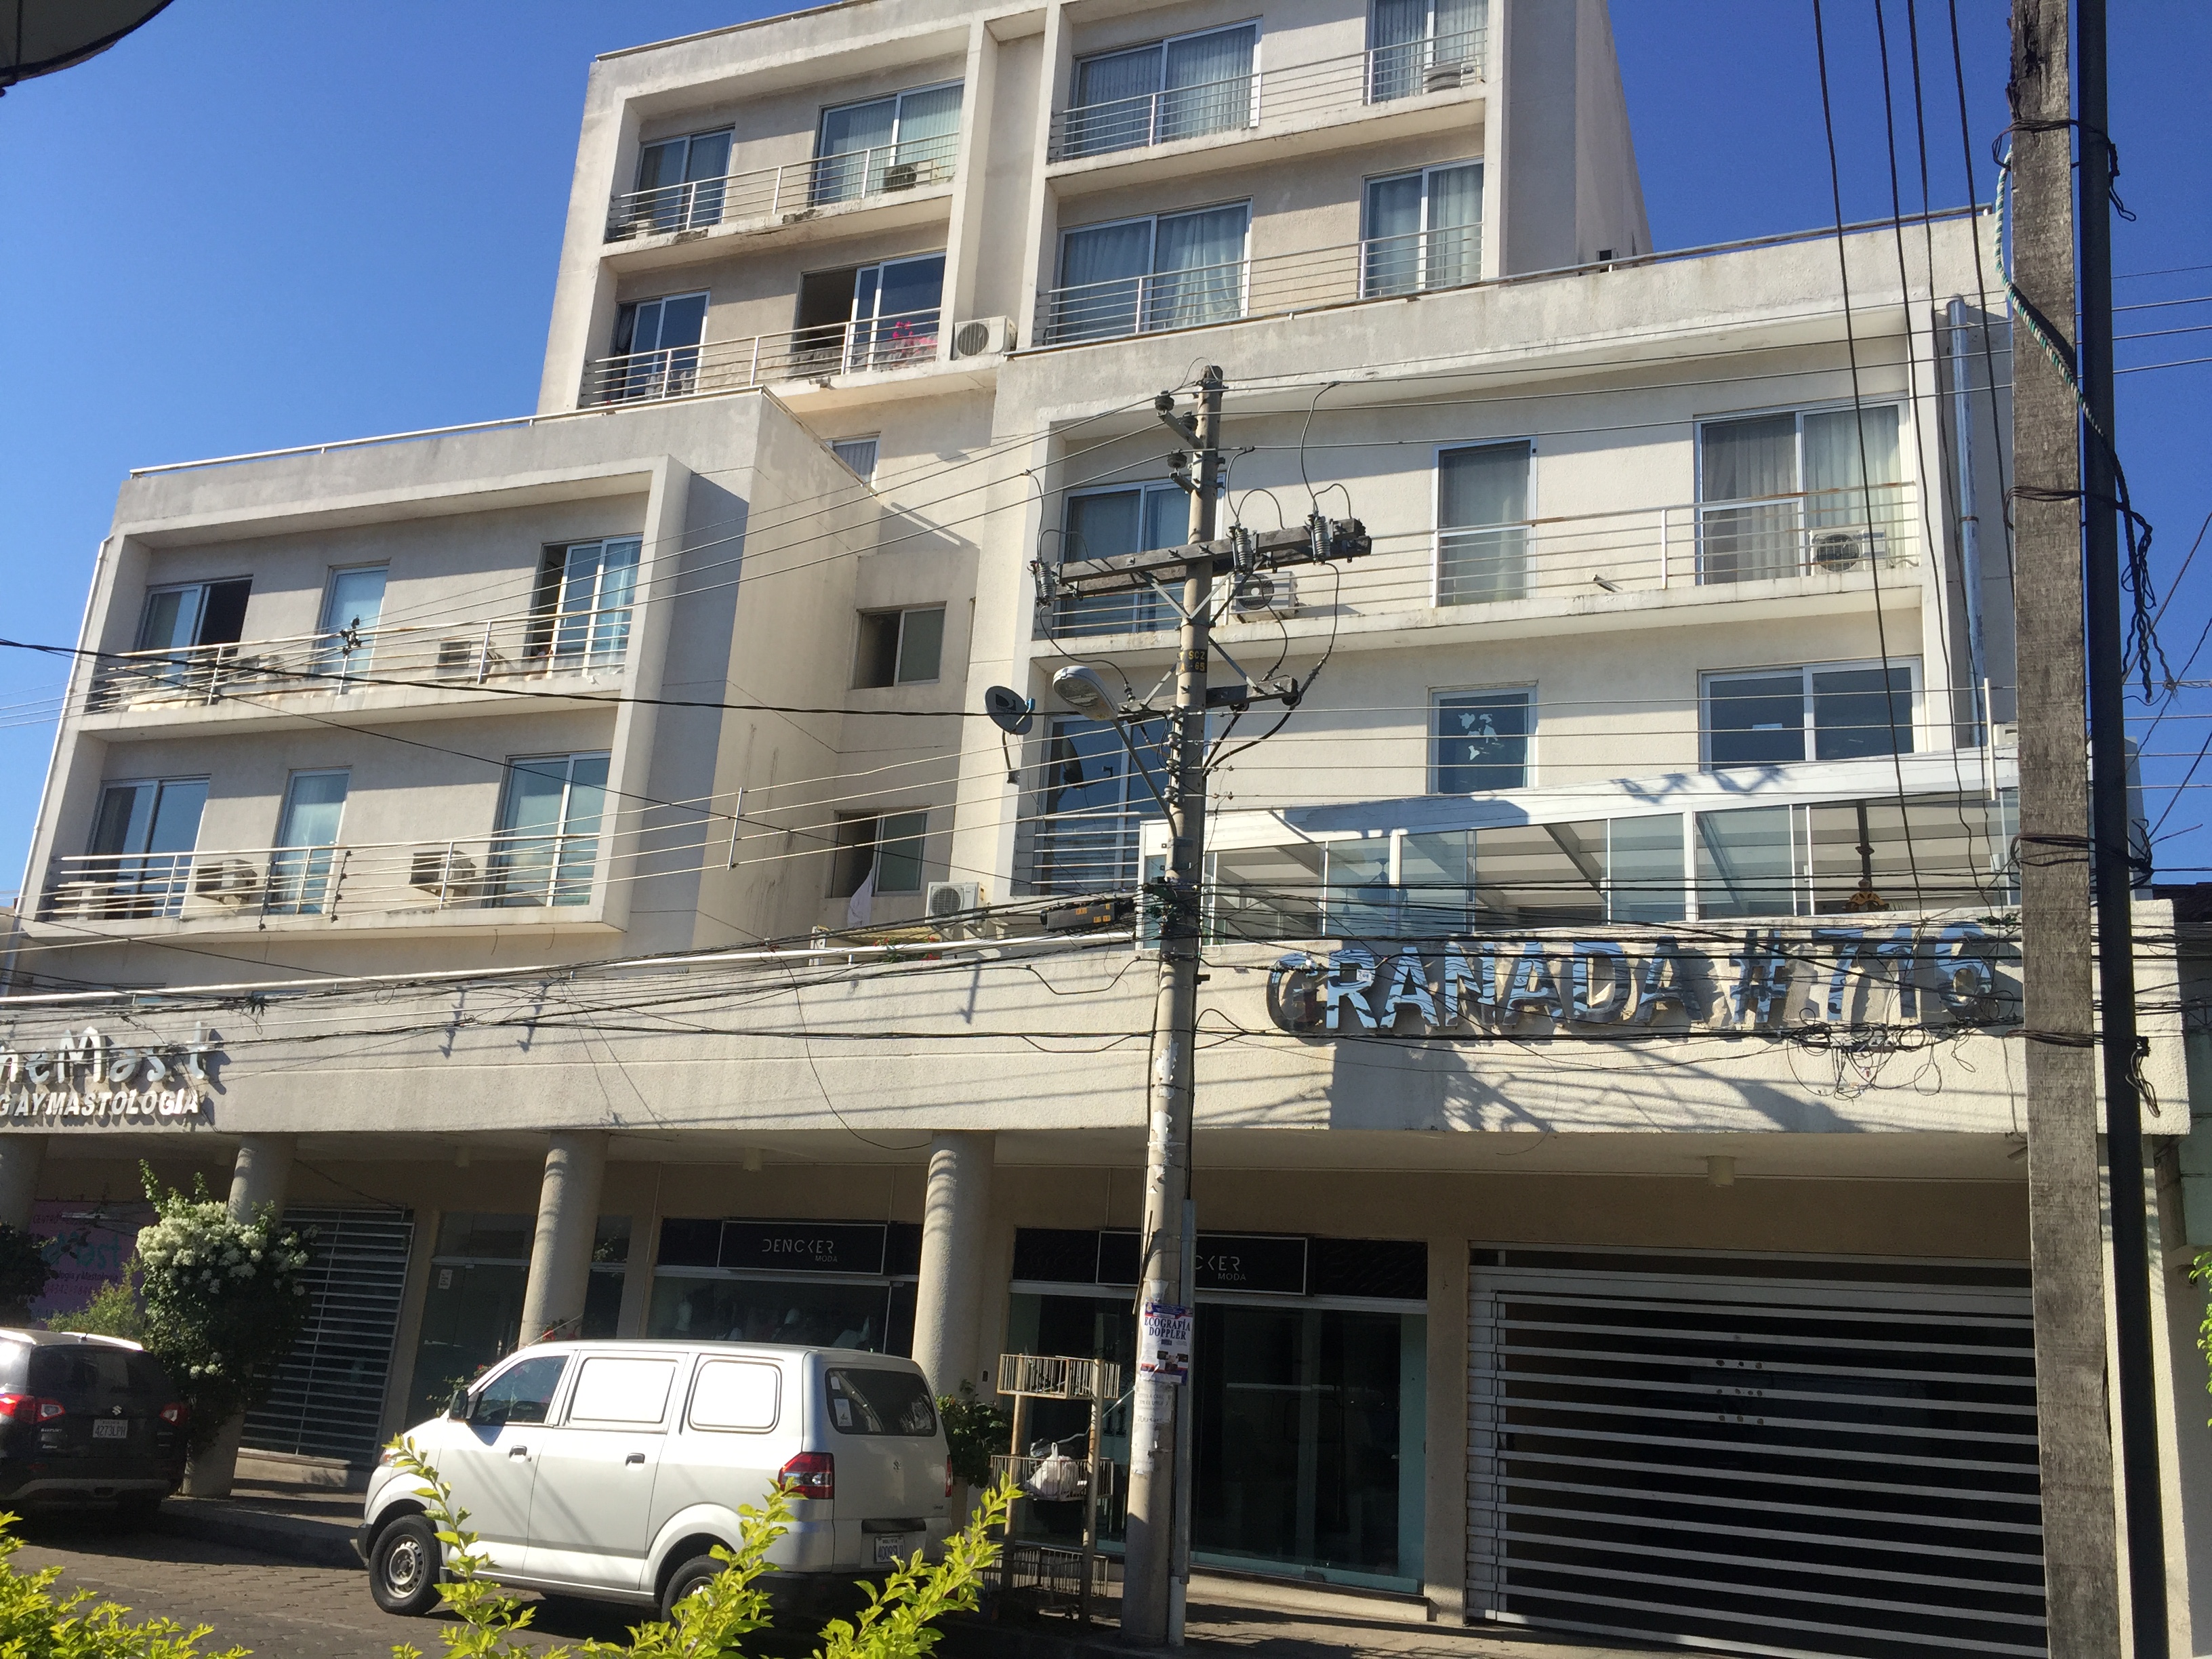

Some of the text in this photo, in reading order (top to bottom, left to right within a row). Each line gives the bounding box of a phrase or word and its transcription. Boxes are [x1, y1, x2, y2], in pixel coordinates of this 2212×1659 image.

[1189, 651, 1205, 659] SCZ
[1266, 935, 1704, 1032] GRANADA
[762, 1239, 834, 1254] DENCKER
[1195, 1254, 1240, 1271] CKER
[1218, 1273, 1246, 1281] MODA
[1145, 1317, 1191, 1332] ECOGRAFÍA
[1149, 1327, 1186, 1340] DOPPLER
